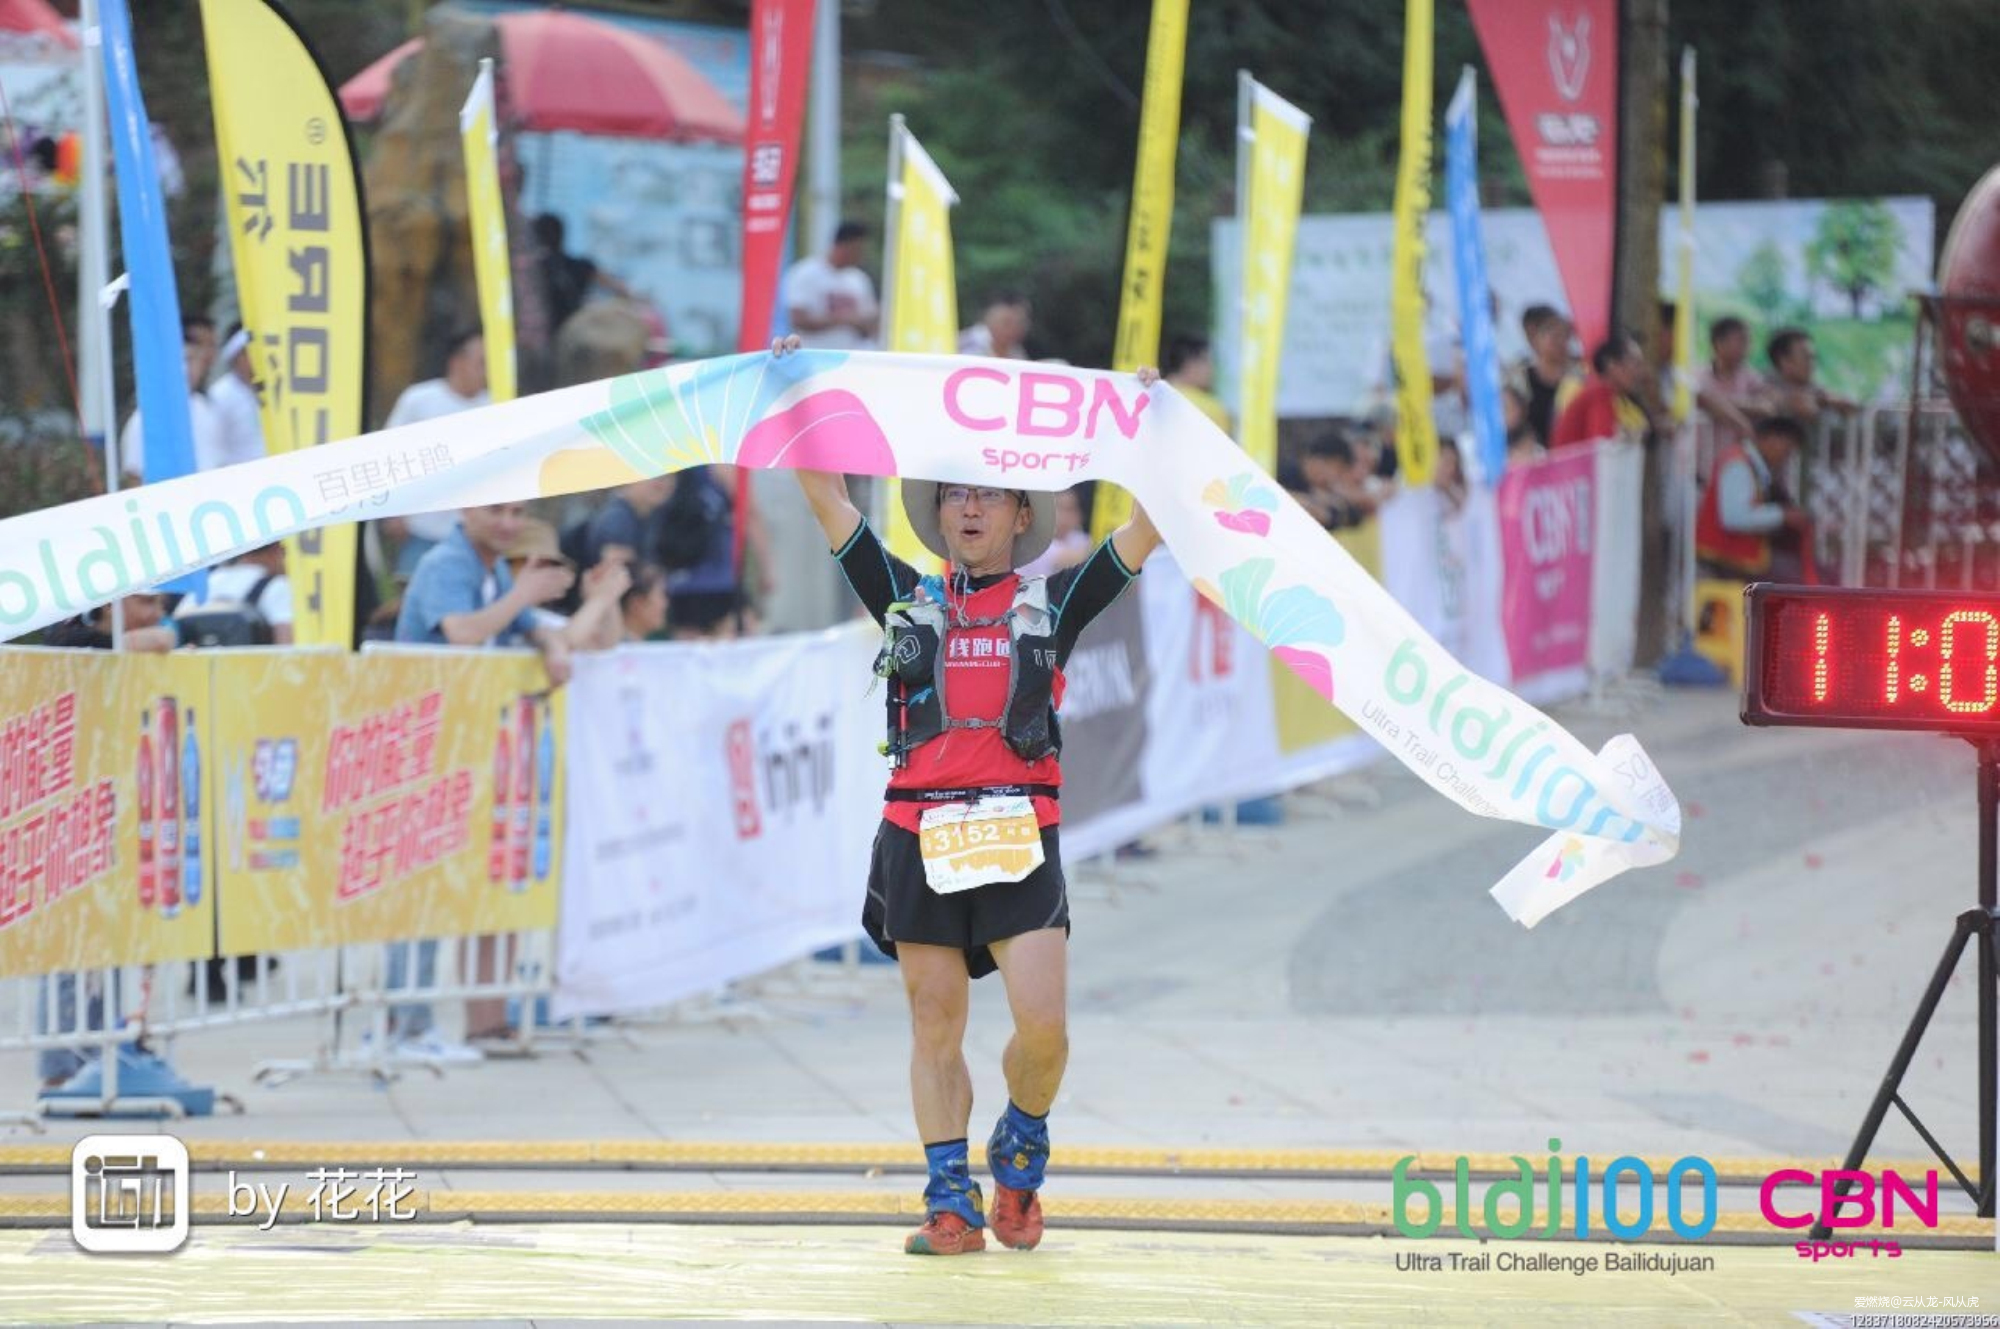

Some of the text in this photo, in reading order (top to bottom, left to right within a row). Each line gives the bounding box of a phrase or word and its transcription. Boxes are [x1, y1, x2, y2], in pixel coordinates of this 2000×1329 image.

[943, 367, 1150, 440] CBN
[313, 443, 456, 502] 百里杜鹃
[982, 447, 1090, 473] sports
[1814, 611, 1999, 712] 11:0
[1362, 699, 1400, 738] Ultra
[1404, 729, 1438, 768] Trail
[933, 823, 1001, 853] 3152
